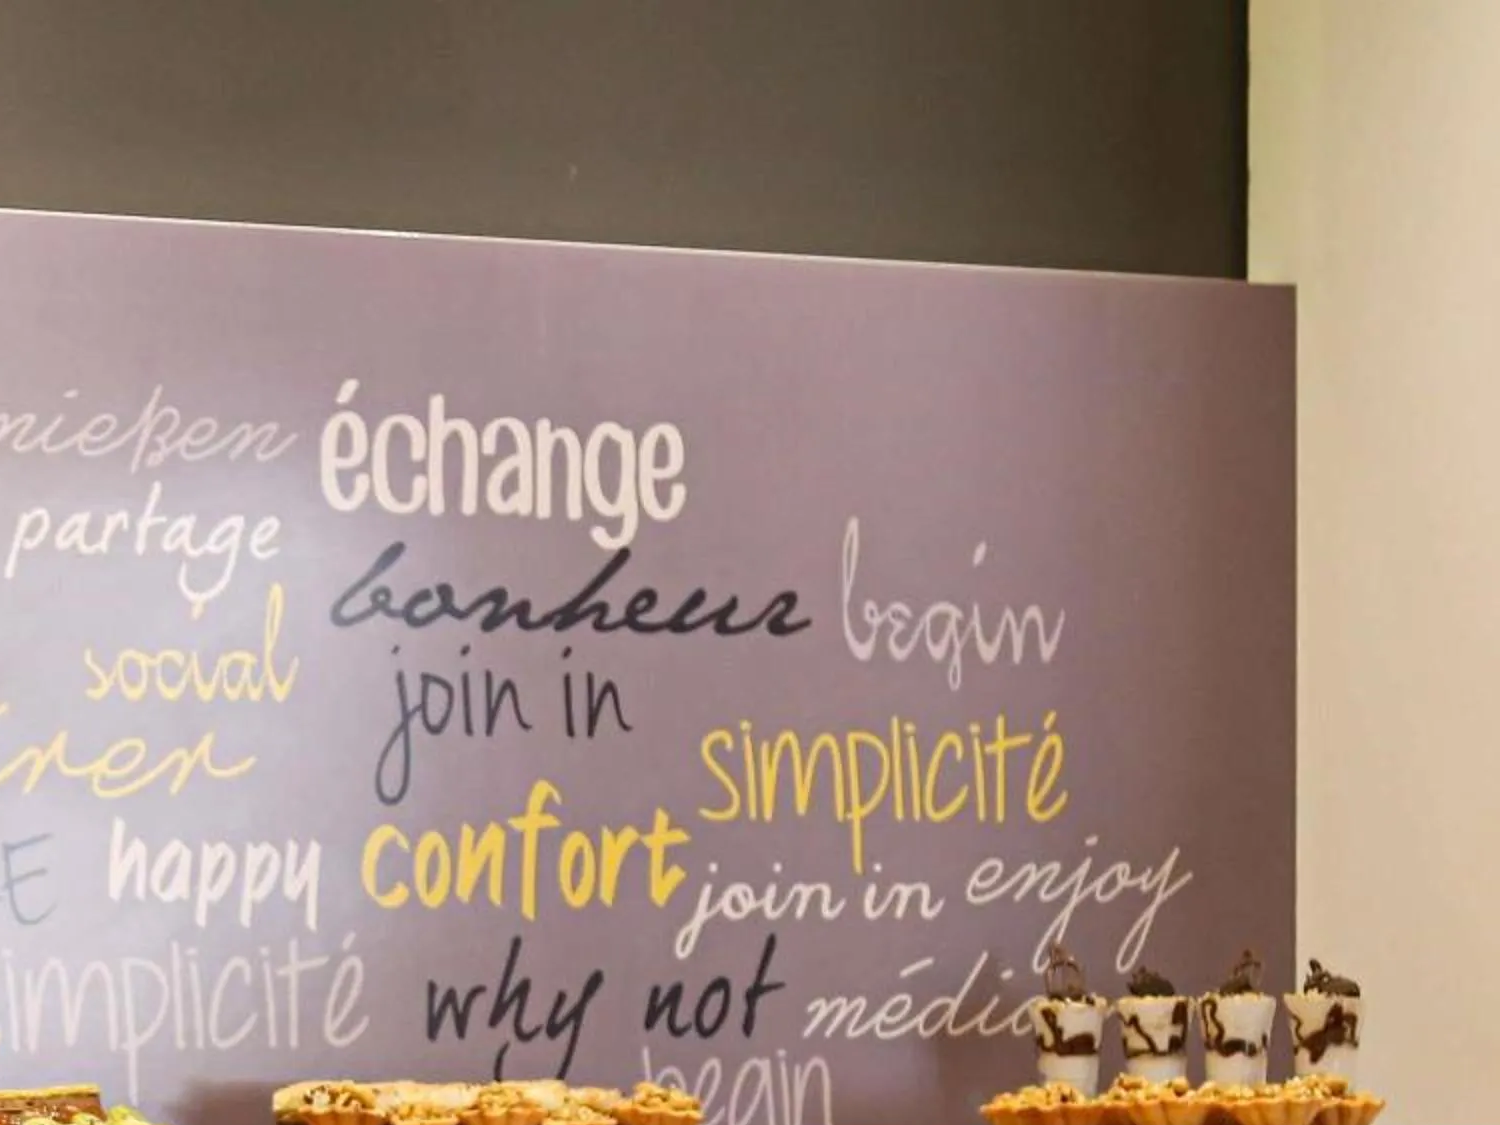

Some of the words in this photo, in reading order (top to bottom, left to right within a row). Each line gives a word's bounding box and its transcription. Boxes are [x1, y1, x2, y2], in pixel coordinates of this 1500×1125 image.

[320, 379, 685, 549] échange
[4, 482, 281, 599] partage
[331, 542, 811, 637] bonheur
[840, 517, 1065, 691] begin
[86, 583, 298, 703] social
[375, 645, 533, 806] join
[561, 647, 634, 739] in
[700, 711, 1068, 874] simplicité
[108, 817, 321, 930] happy
[361, 780, 690, 921] confort
[674, 861, 846, 960] join
[860, 865, 946, 923] in
[964, 835, 1193, 975] enjoy
[427, 936, 604, 1082] why
[644, 933, 786, 1040] not
